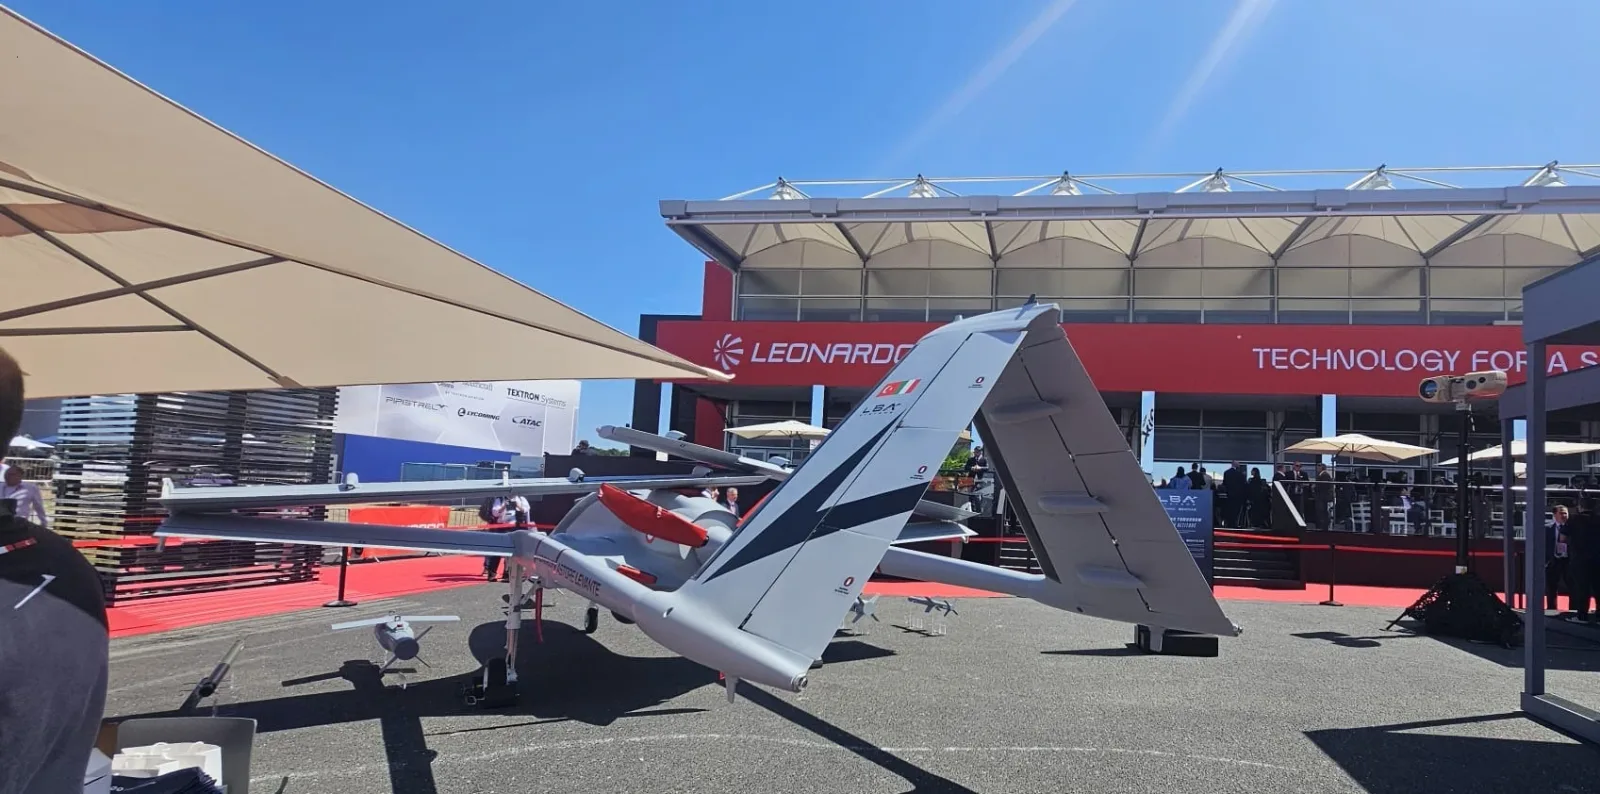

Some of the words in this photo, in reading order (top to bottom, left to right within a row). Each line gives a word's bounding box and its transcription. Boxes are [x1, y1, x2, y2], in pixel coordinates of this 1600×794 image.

[1252, 348, 1460, 371] TECHNOLOGY
[1547, 351, 1568, 373] A
[385, 396, 439, 411] PIPISTREL
[507, 388, 540, 401] TEXTRON
[540, 394, 566, 408] Systems
[467, 410, 500, 421] LYCOMING
[520, 417, 542, 428] ATAC
